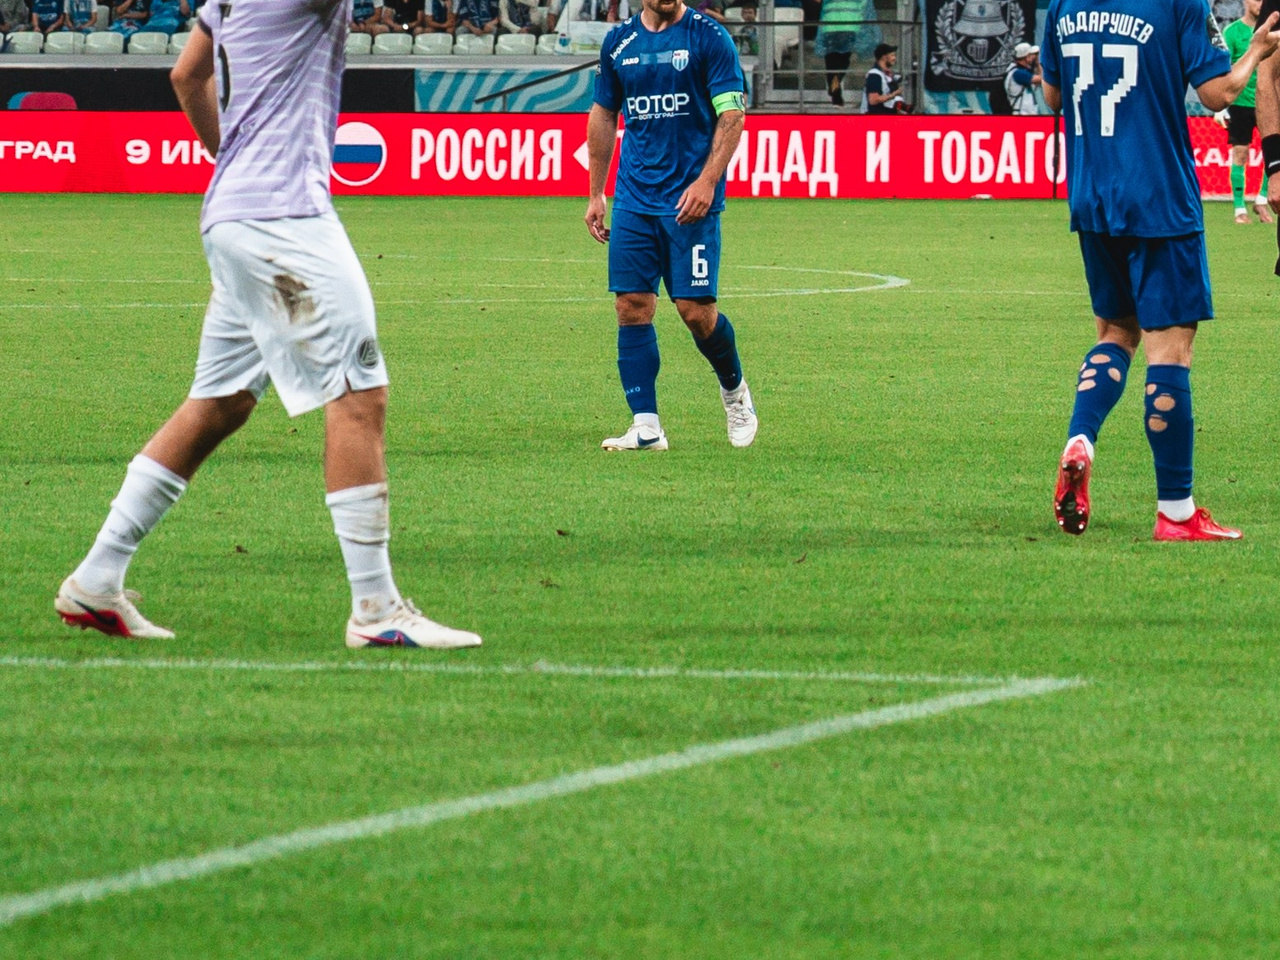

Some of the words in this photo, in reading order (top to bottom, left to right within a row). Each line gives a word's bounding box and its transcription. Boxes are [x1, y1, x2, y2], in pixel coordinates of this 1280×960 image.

[622, 57, 640, 66] JAKO
[626, 93, 690, 116] РОТОР
[1061, 43, 1138, 137] 77
[125, 140, 150, 164] 9
[410, 128, 563, 181] РОССИЯ
[865, 131, 890, 182] И
[917, 131, 1066, 183] ТОБАГО
[692, 244, 709, 278] 6
[691, 279, 709, 287] JAKO
